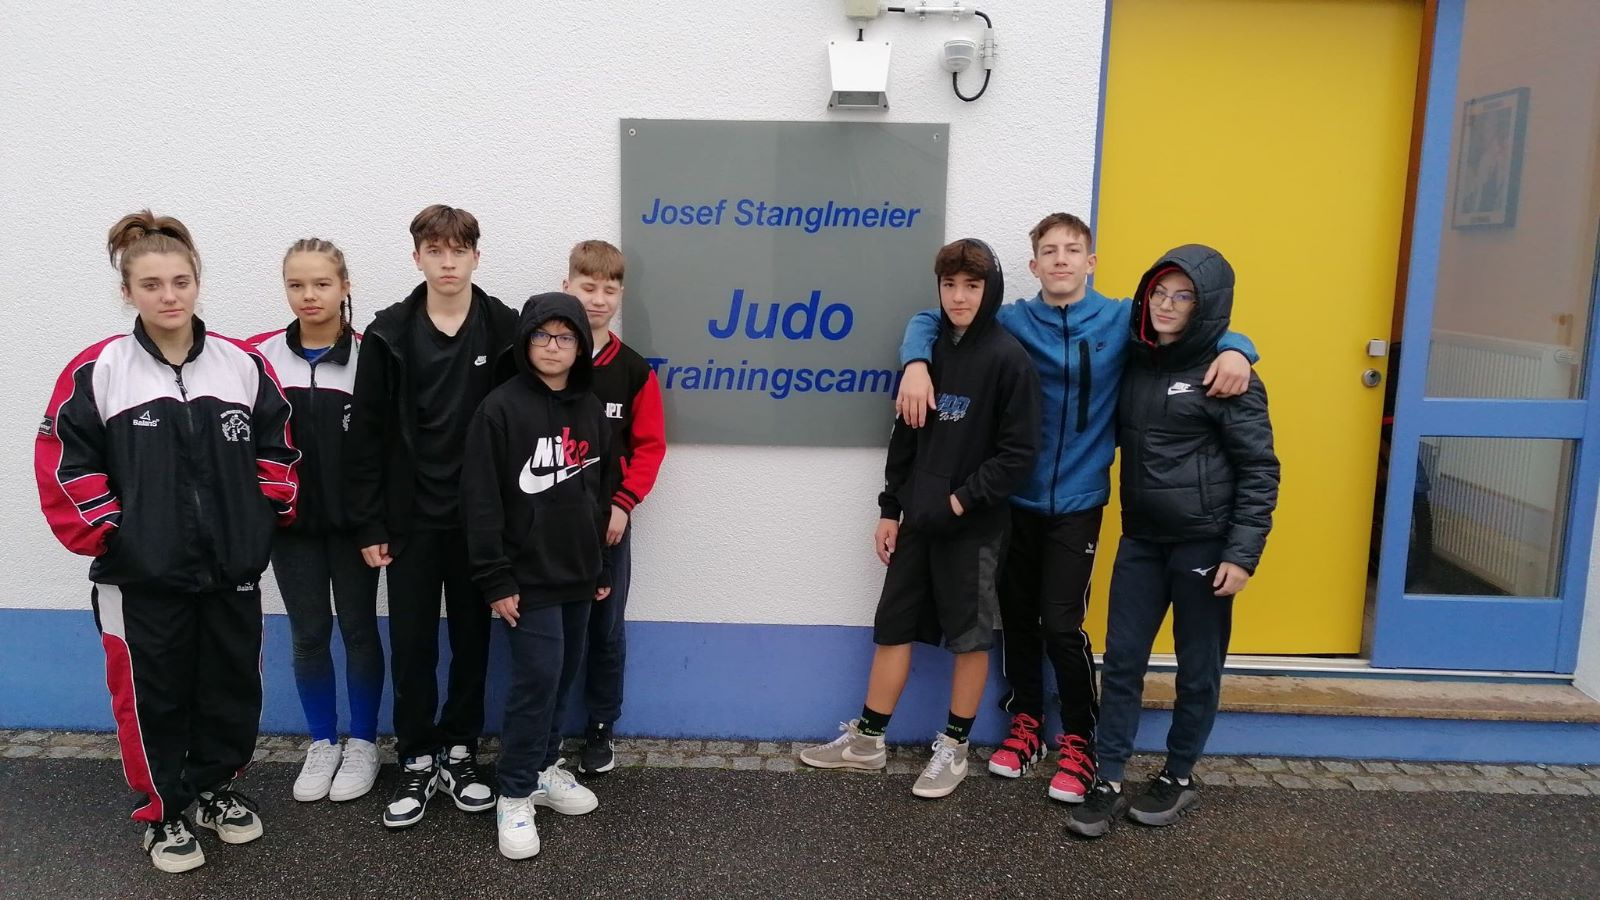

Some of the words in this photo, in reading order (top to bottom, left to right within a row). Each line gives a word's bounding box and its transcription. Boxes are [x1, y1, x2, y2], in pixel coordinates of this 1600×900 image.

[641, 198, 726, 225] Josef
[735, 199, 920, 234] Stanglmeier
[707, 289, 854, 341] Judo
[531, 426, 590, 469] Nike
